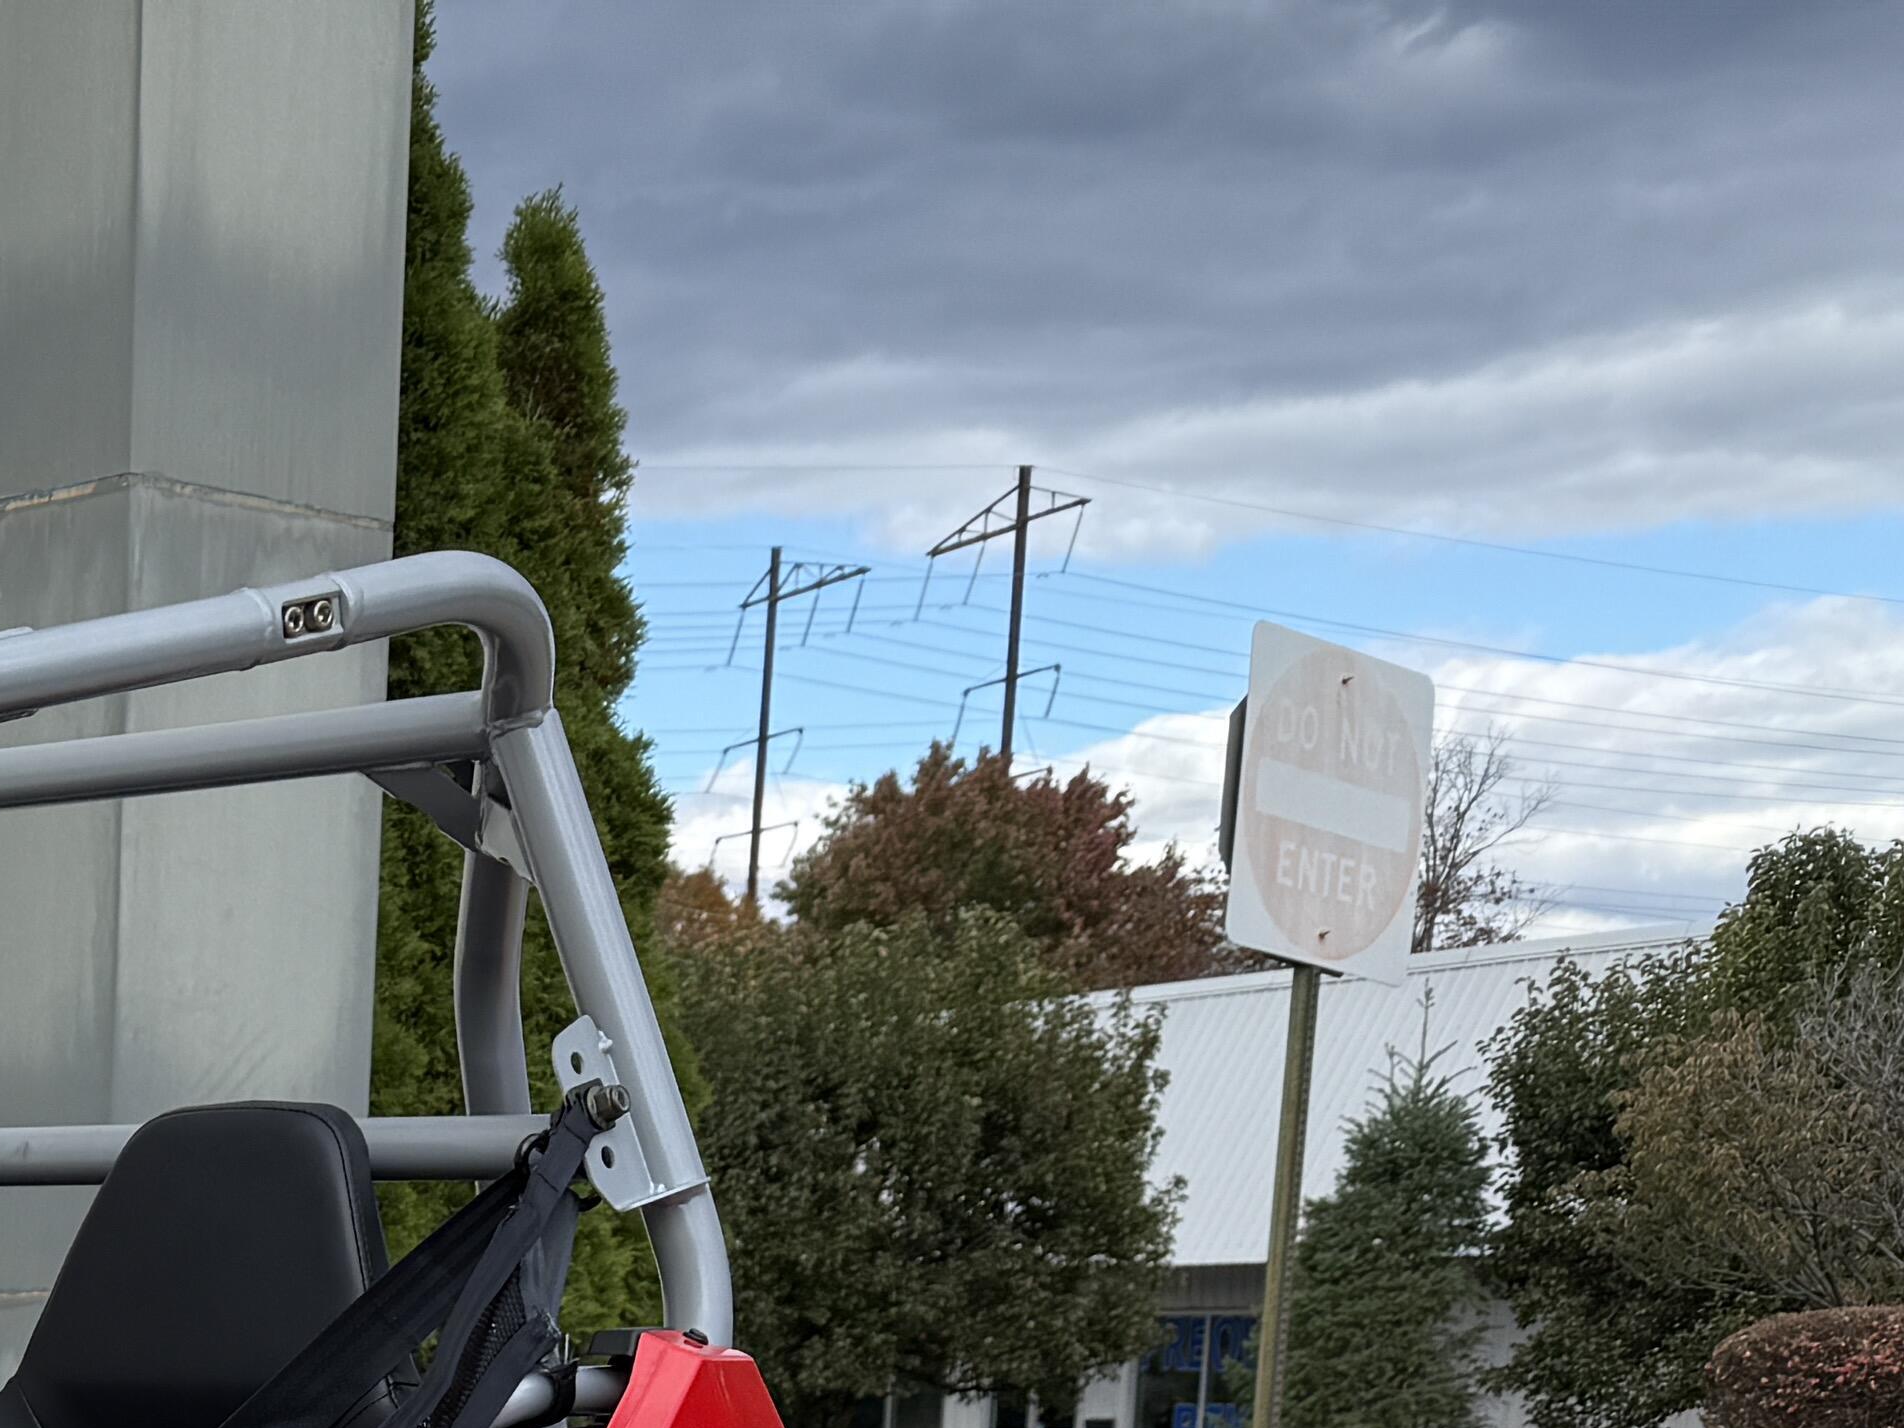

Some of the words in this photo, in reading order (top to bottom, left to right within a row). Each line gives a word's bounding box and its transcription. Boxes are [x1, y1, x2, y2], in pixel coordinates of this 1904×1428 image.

[1278, 703, 1318, 749] DO
[1339, 724, 1401, 776] NOT
[1278, 844, 1376, 910] ENTER
